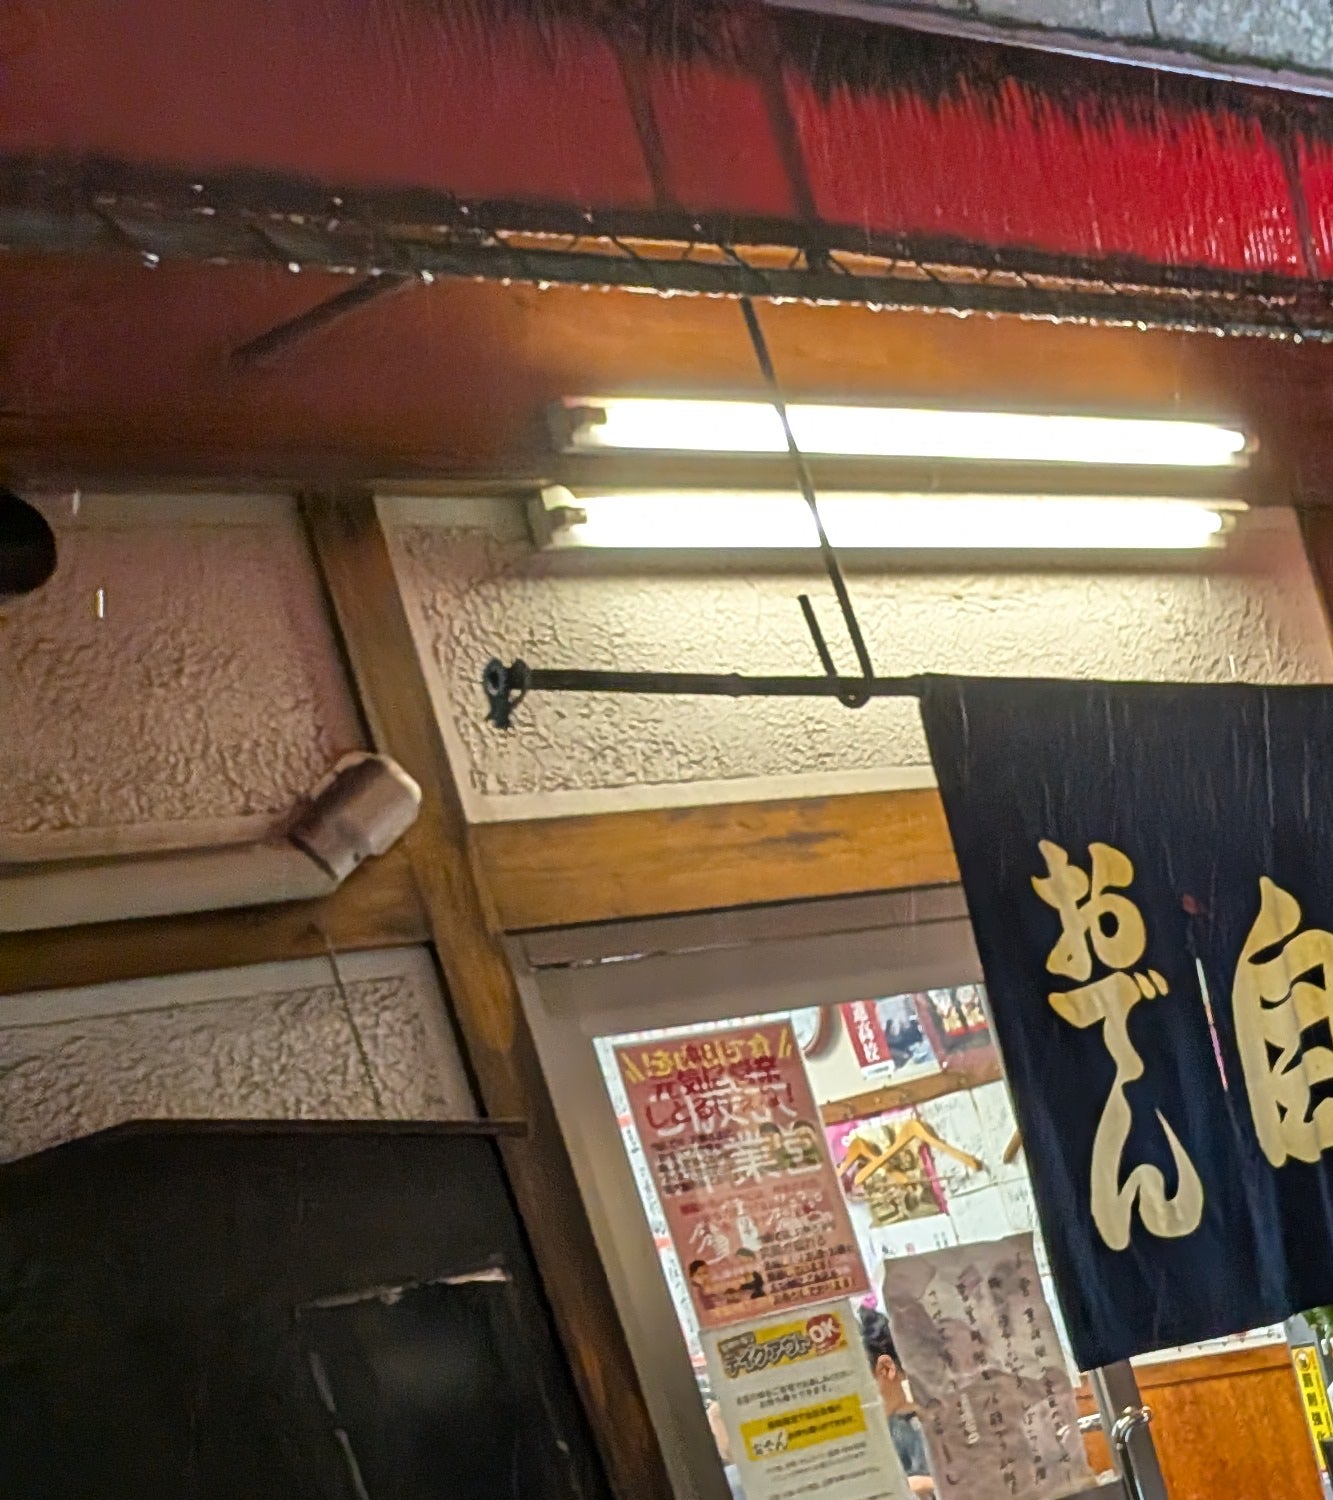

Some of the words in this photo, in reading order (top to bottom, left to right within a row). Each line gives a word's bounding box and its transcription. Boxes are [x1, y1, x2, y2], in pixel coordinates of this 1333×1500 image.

[1031, 838, 1203, 1251] おでん
[808, 1316, 841, 1344] OK
